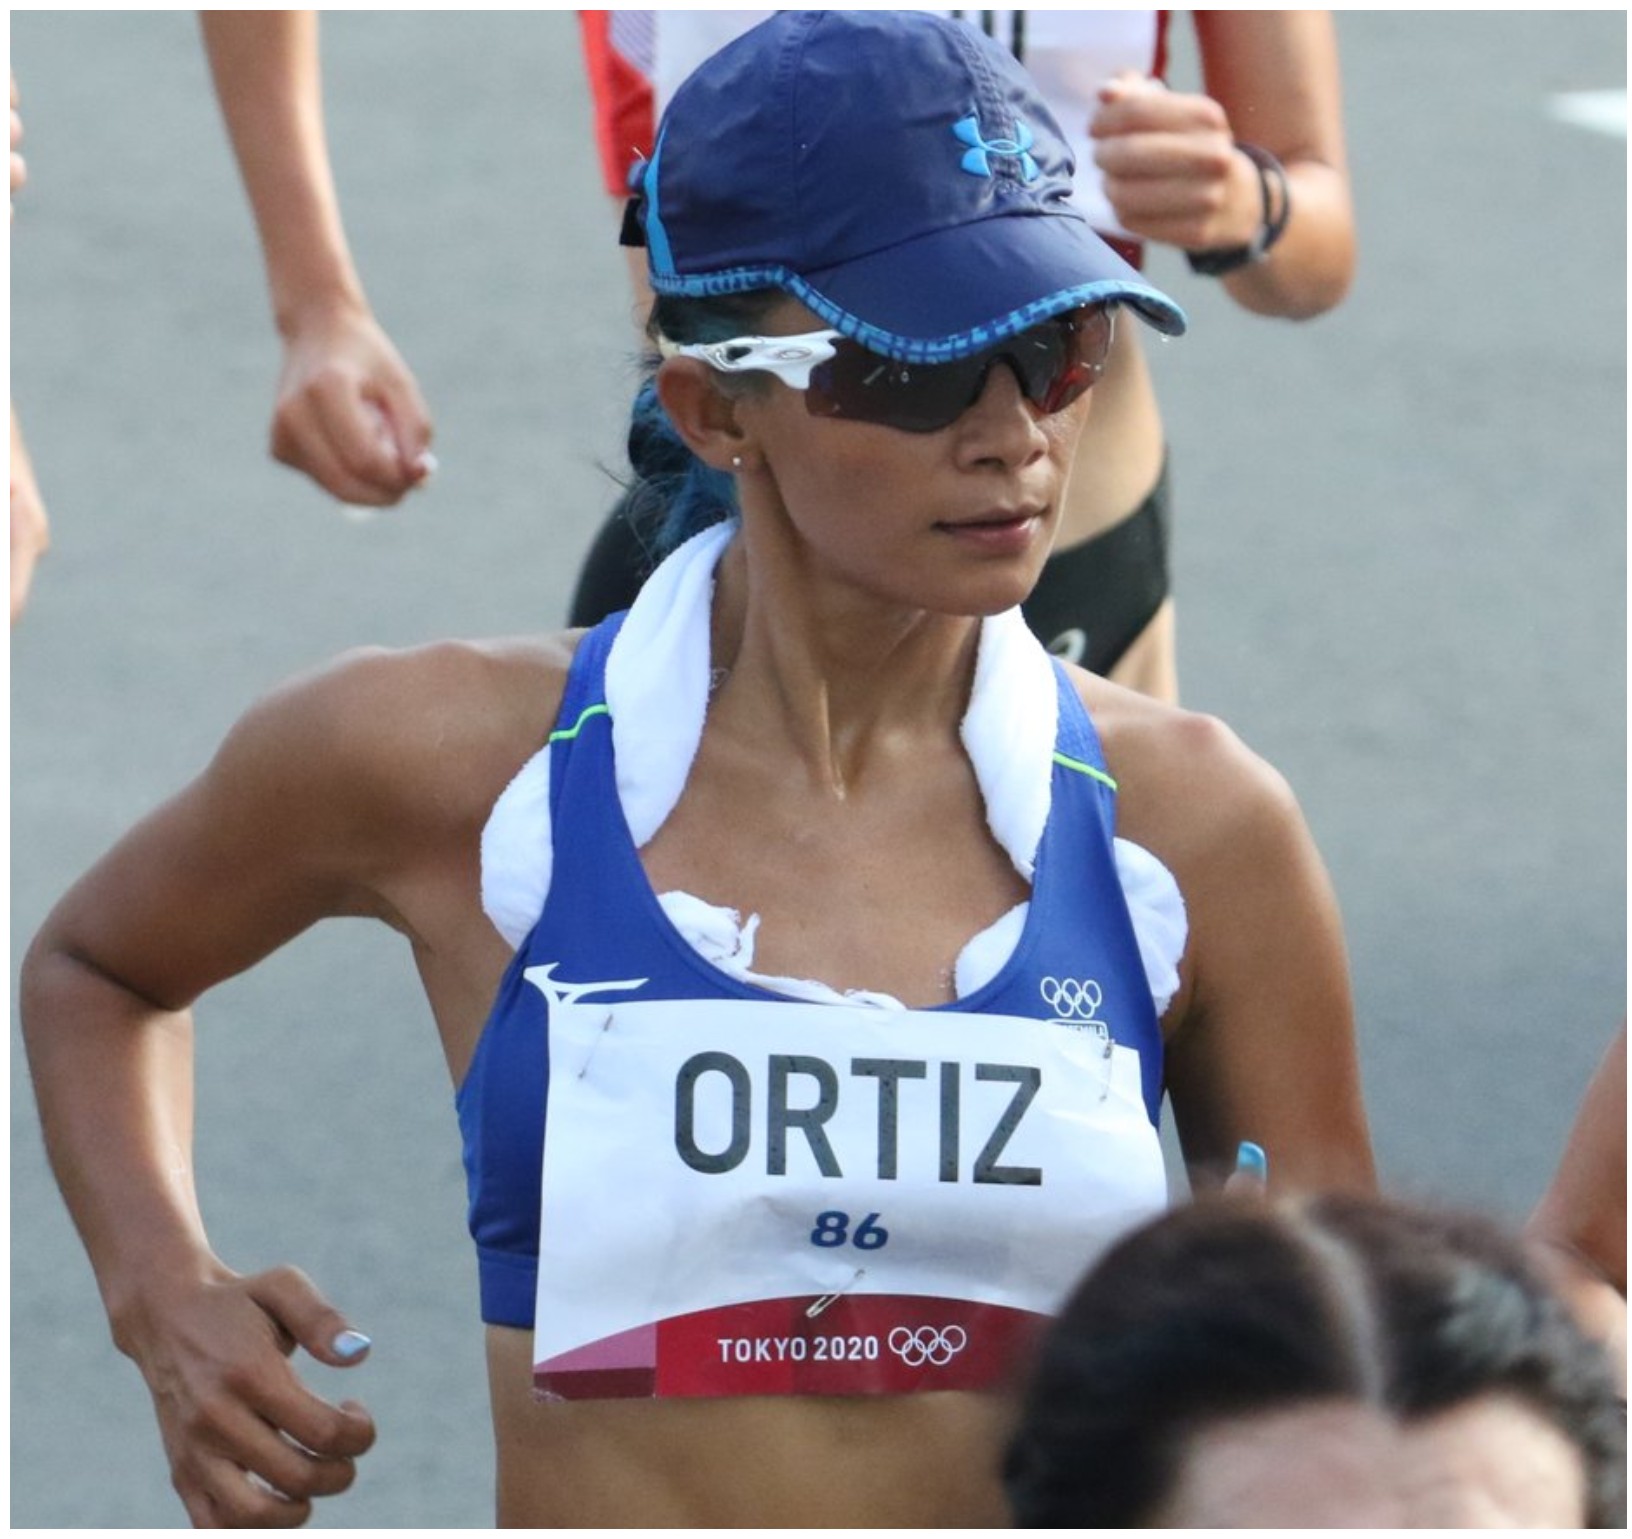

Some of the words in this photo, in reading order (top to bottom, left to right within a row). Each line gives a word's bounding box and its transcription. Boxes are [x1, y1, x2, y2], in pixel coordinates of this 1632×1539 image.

[673, 1050, 1043, 1187] ORTIZ
[809, 1210, 889, 1251] 86
[716, 1336, 806, 1363] TOKYO
[812, 1335, 879, 1361] 2020
